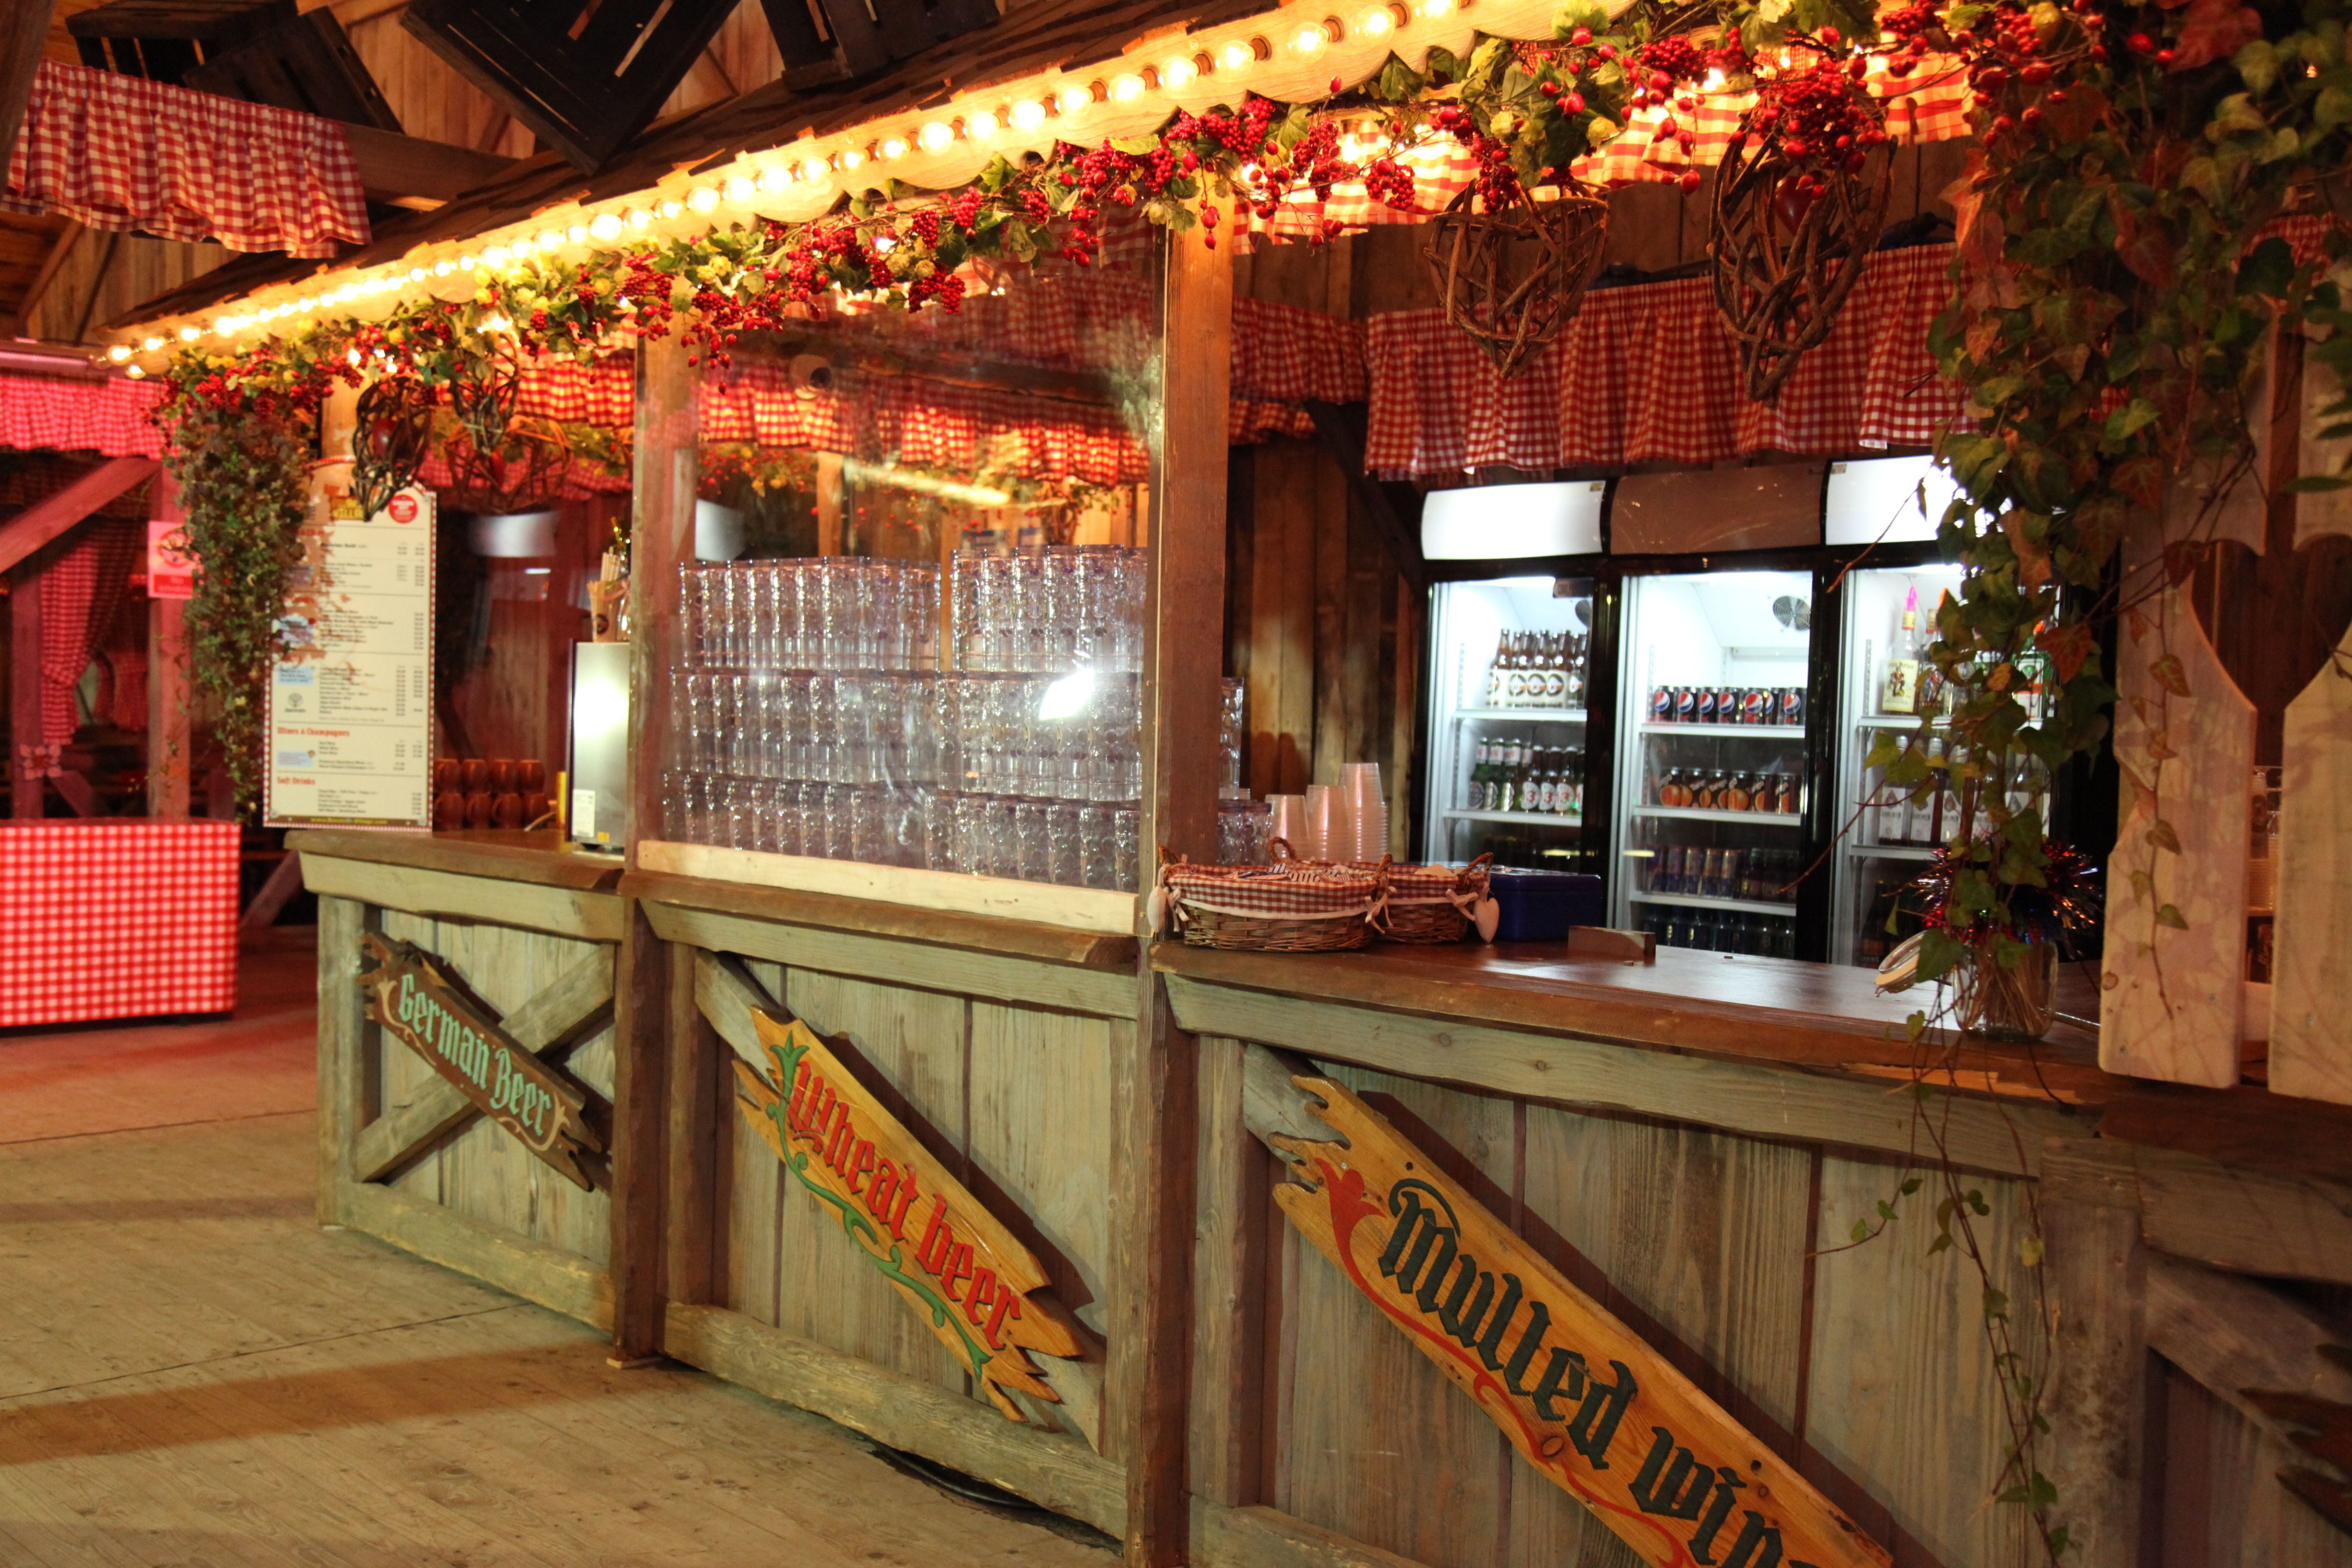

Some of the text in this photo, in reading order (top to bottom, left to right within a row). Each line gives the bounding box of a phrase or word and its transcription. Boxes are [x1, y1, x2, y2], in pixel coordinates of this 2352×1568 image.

[398, 973, 552, 1137] German Beer
[787, 1060, 1021, 1351] Wheat beer
[1377, 1179, 1821, 1568] Mulled win
